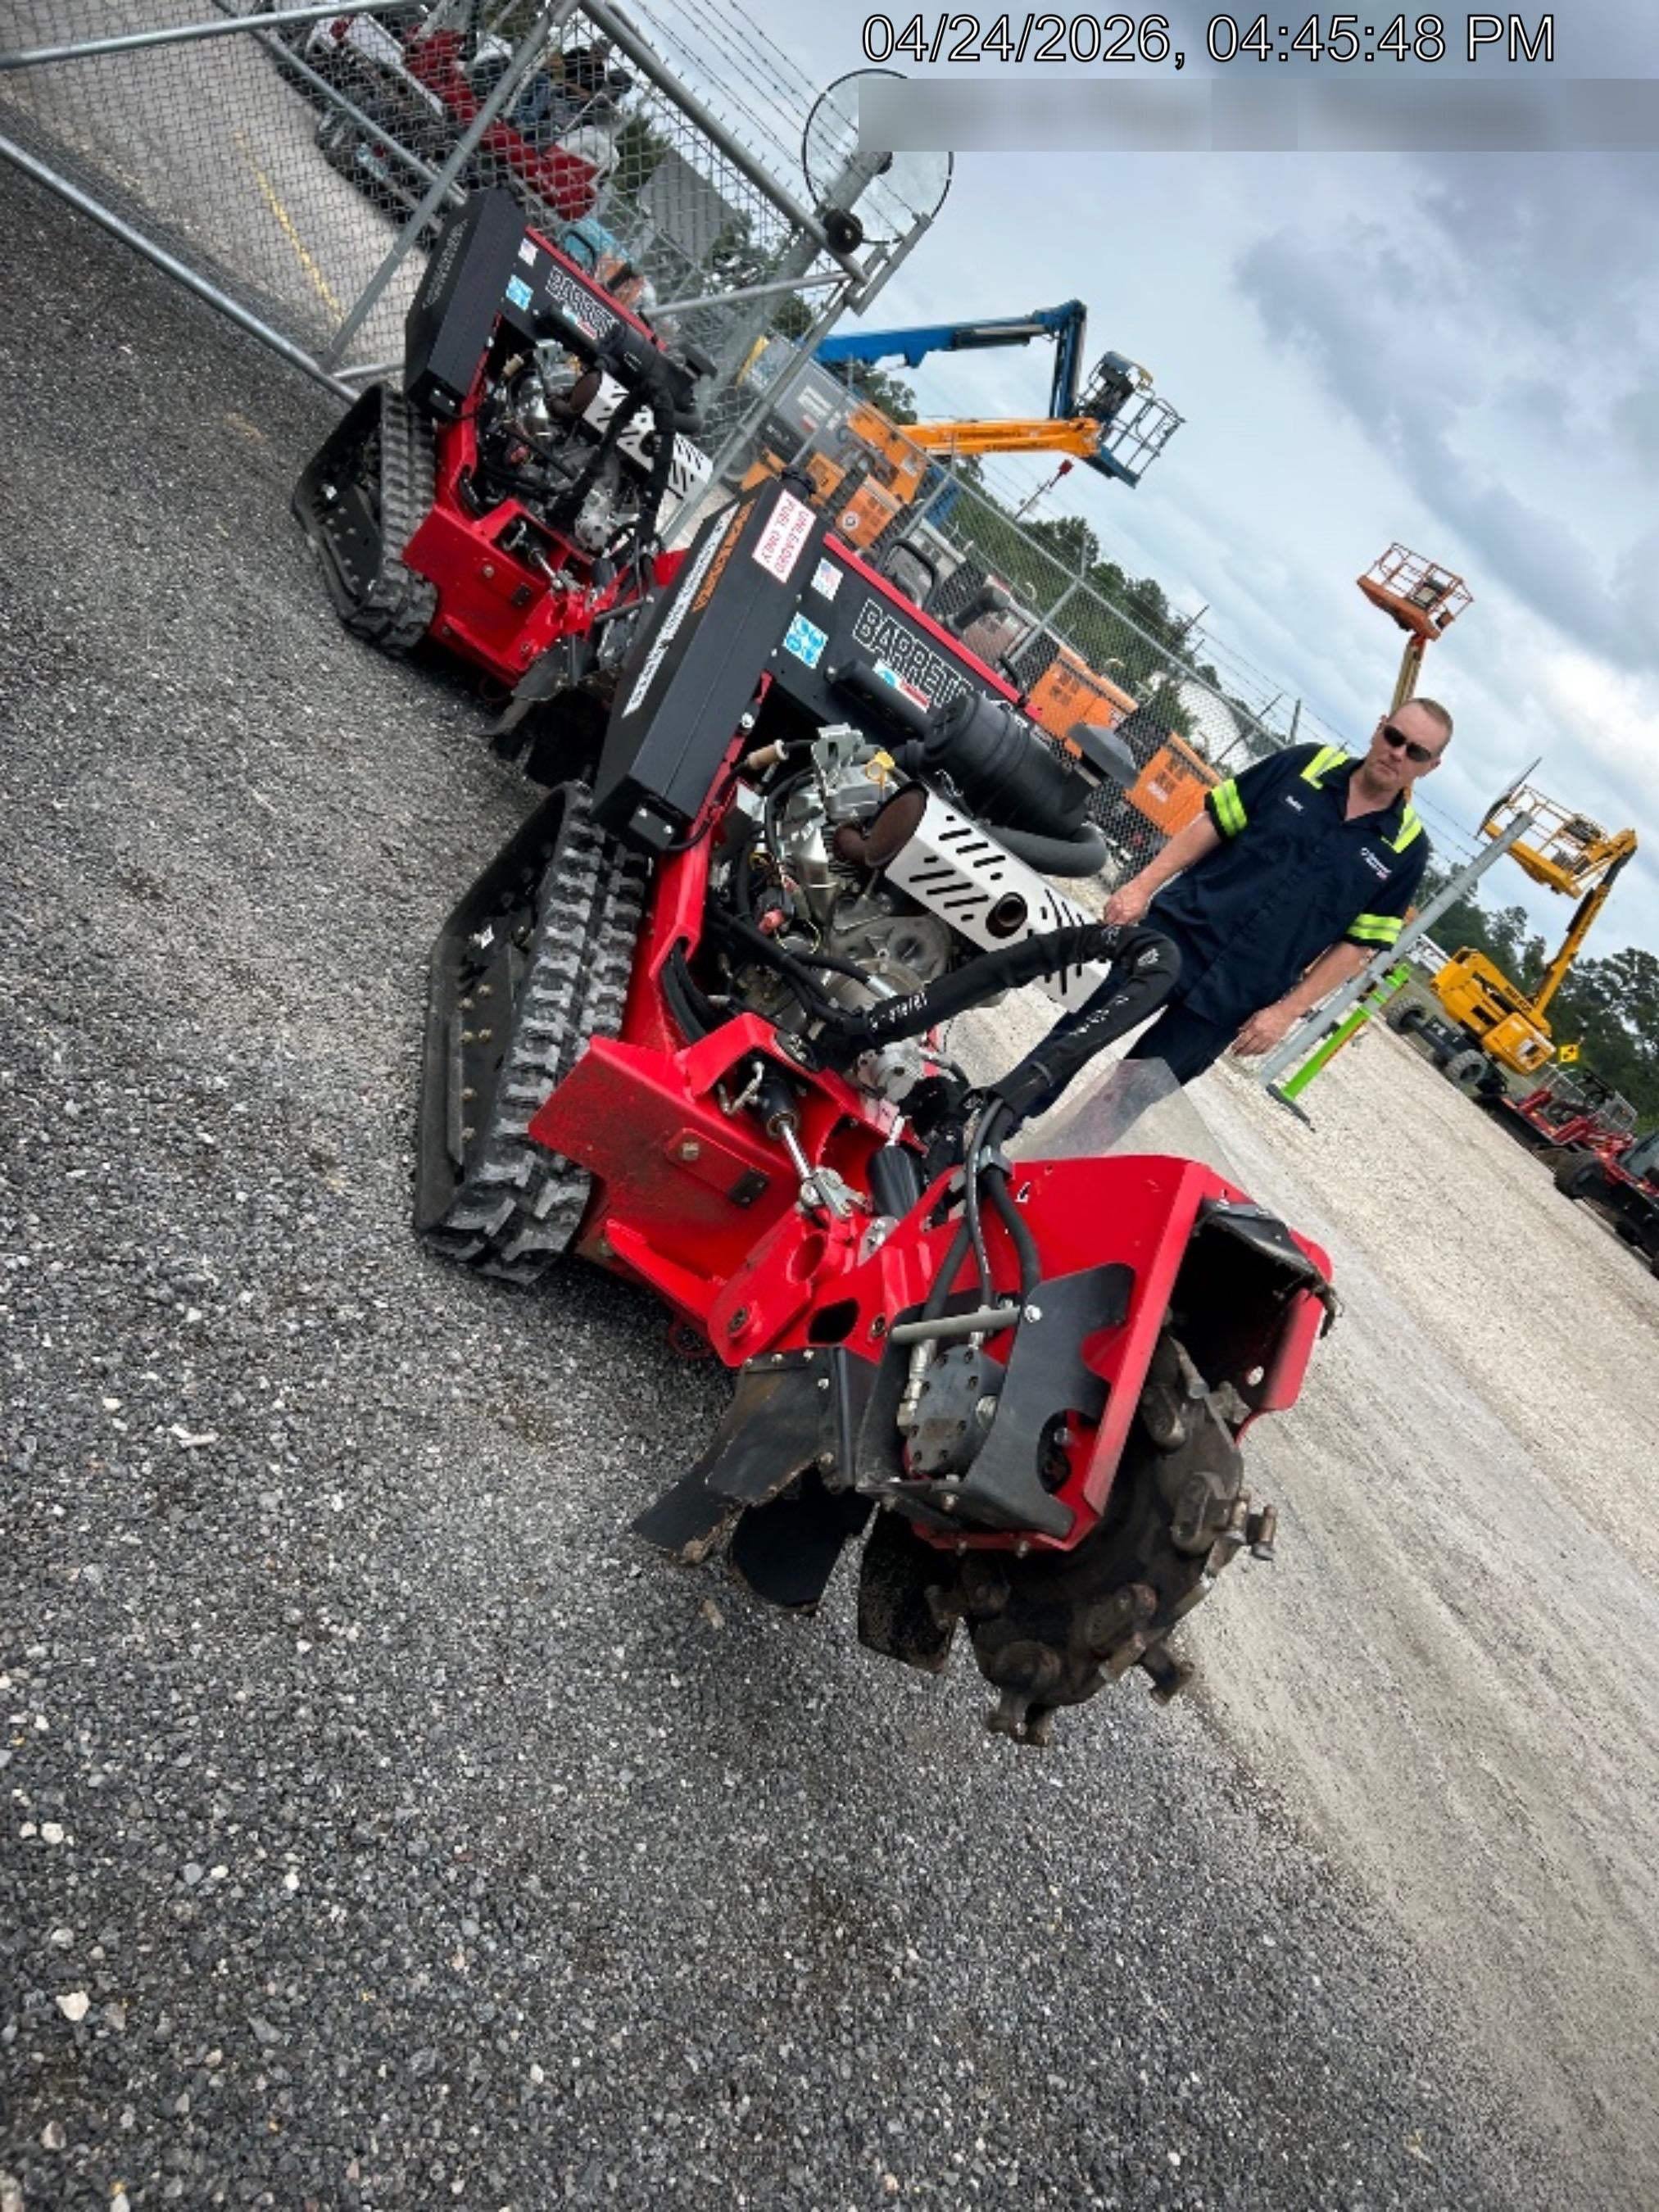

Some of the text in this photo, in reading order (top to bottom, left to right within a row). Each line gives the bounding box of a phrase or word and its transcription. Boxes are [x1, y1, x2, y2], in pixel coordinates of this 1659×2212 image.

[761, 498, 796, 564] FUEL ONLY
[774, 510, 809, 573] UNLEADED
